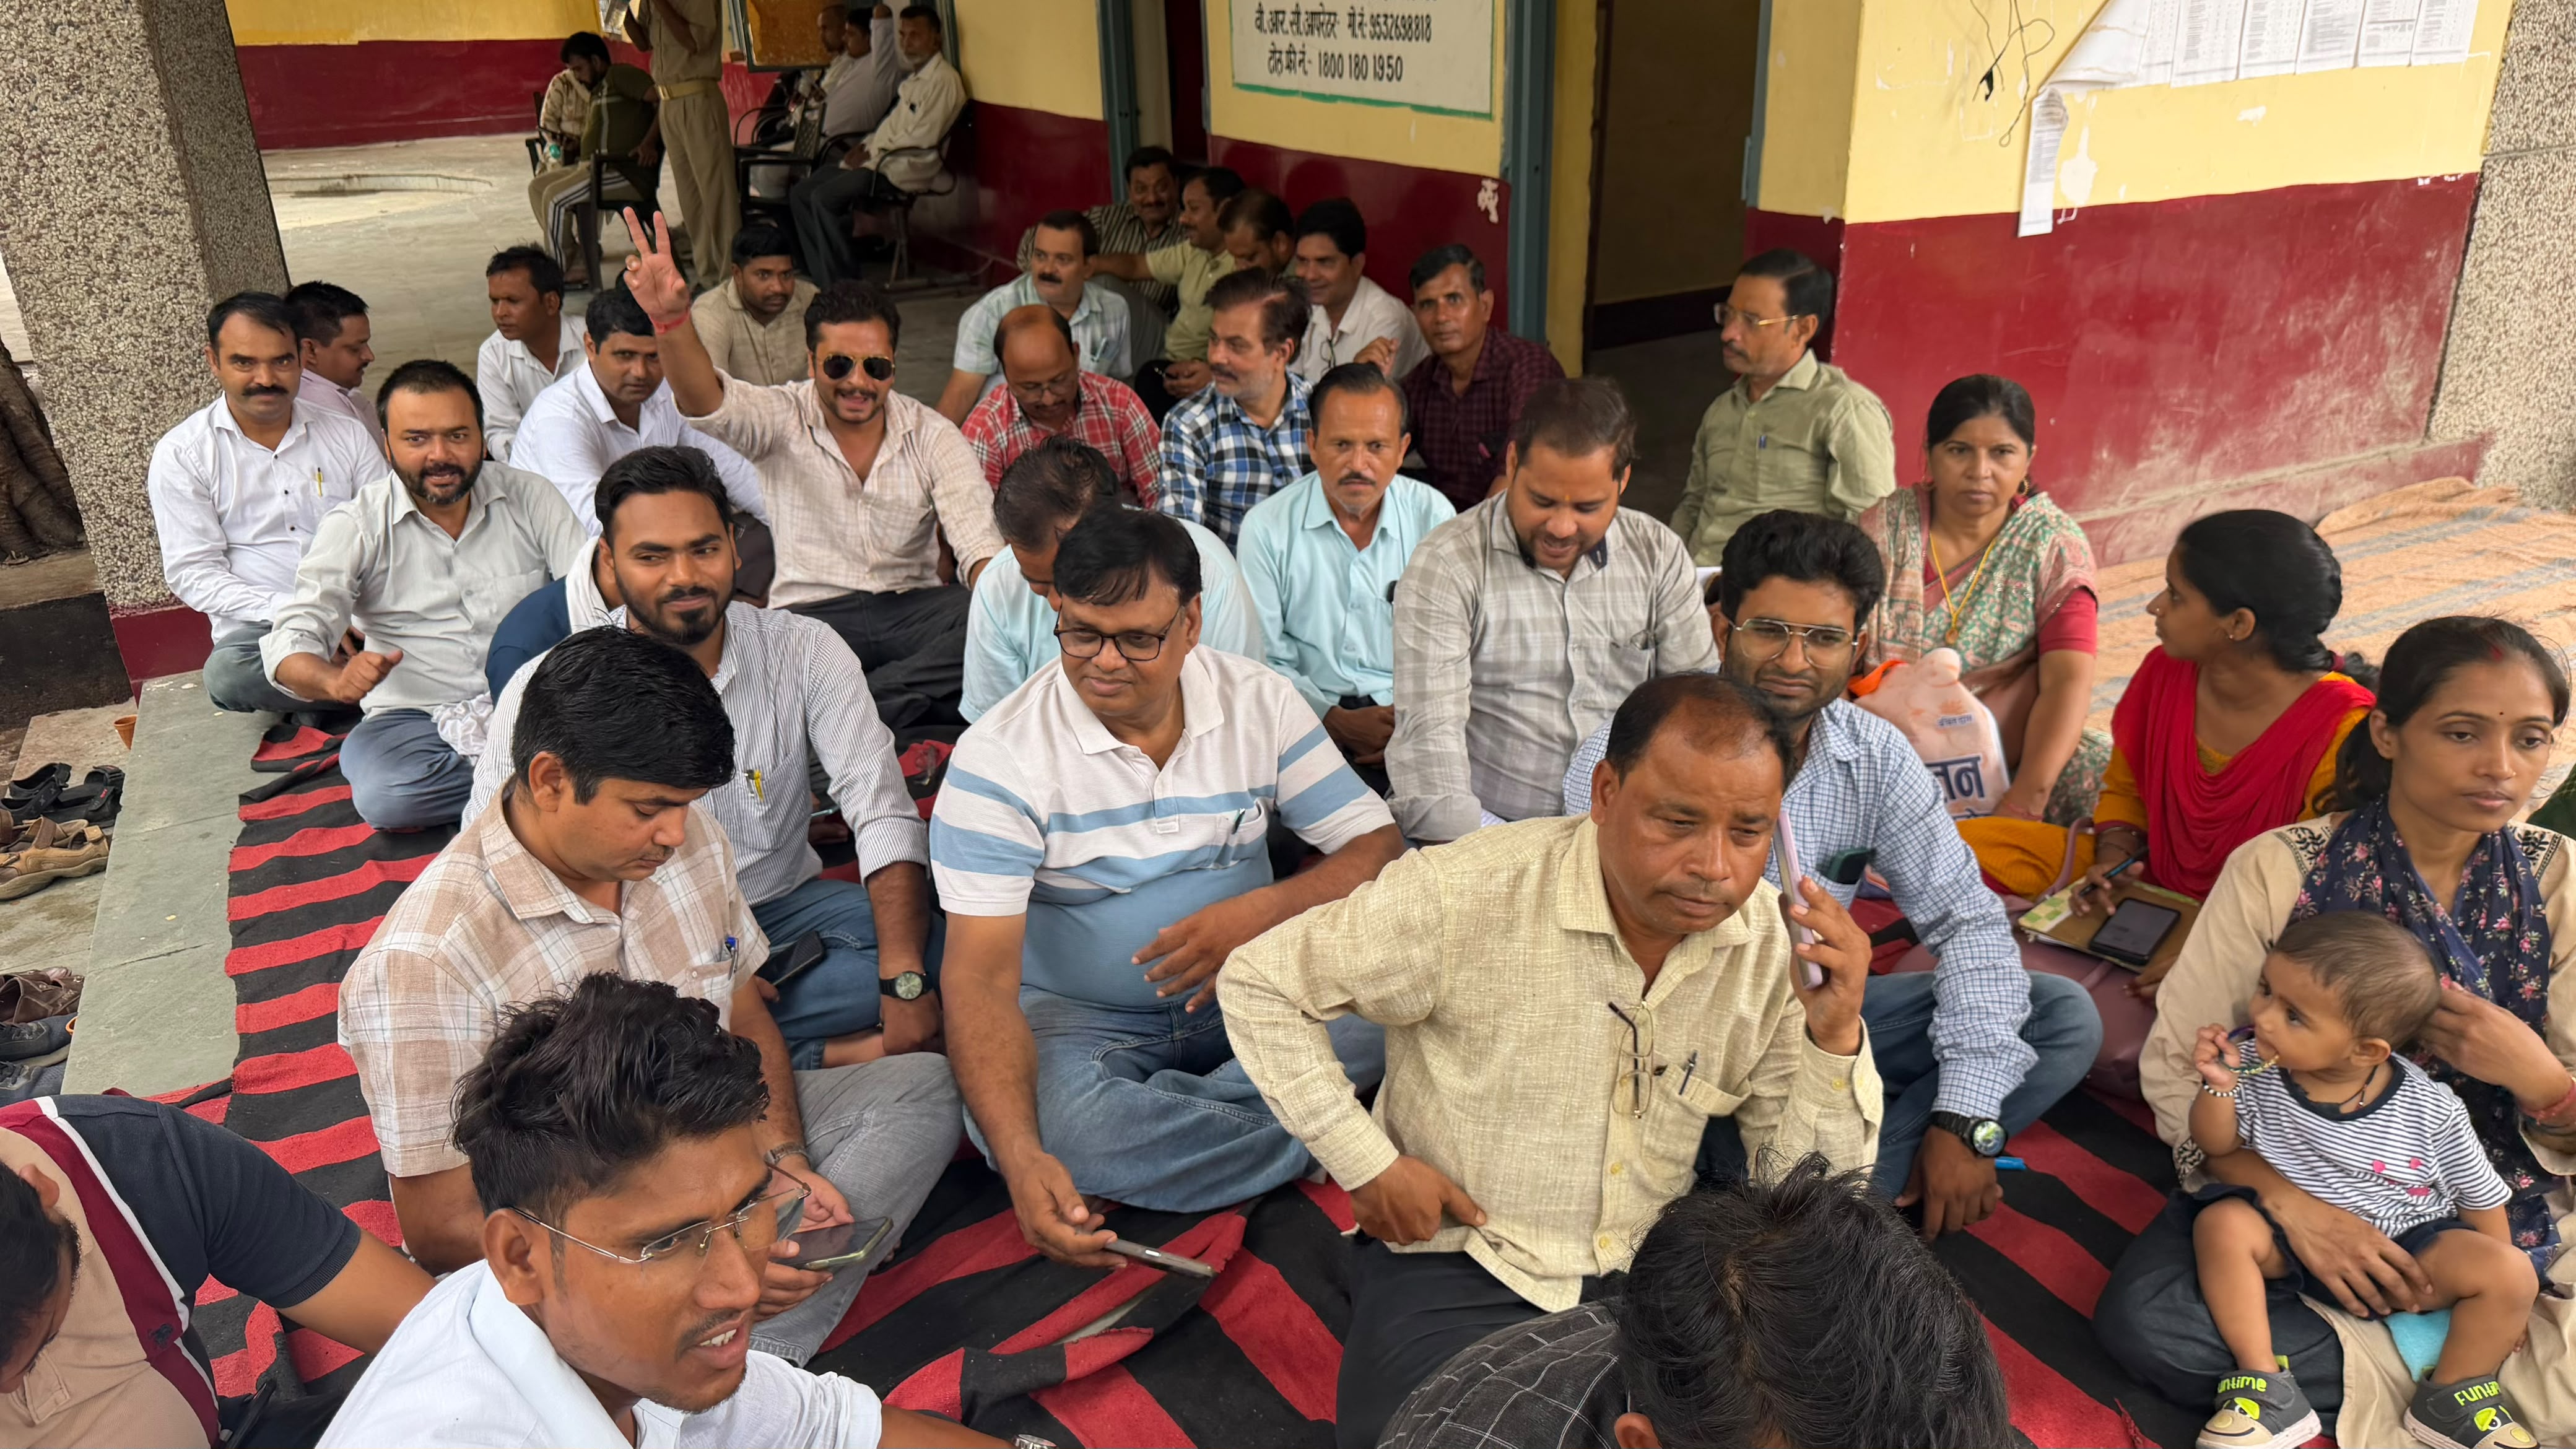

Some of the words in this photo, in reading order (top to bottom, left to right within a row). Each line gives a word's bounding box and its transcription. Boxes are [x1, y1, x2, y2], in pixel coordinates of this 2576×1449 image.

[1370, 14, 1432, 43] 9532698818
[1318, 50, 1344, 79] 1800
[1349, 52, 1369, 81] 180
[1373, 54, 1404, 82] 1950
